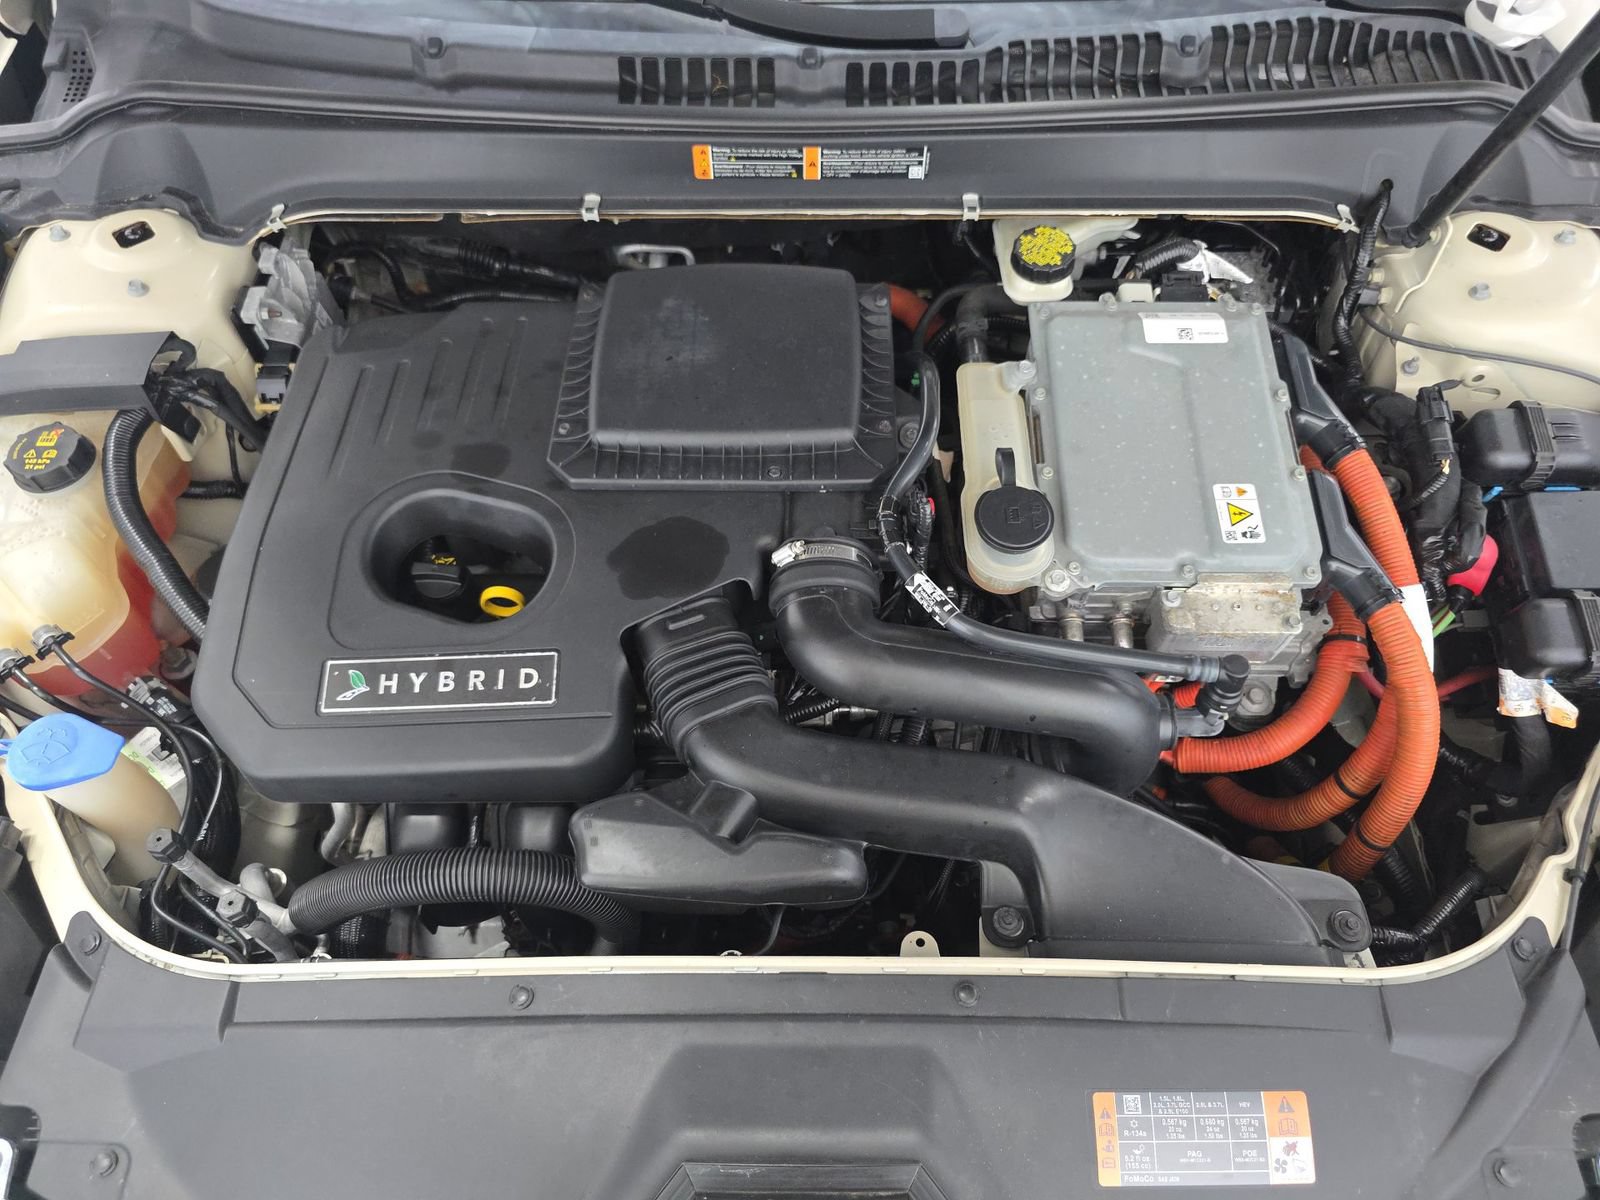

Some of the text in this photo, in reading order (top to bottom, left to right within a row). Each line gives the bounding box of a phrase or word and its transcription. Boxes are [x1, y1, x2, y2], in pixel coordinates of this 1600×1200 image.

[377, 667, 540, 695] HYBRID
[1123, 1129, 1147, 1137] R-134a
[1123, 1174, 1154, 1182] FoMoCo
